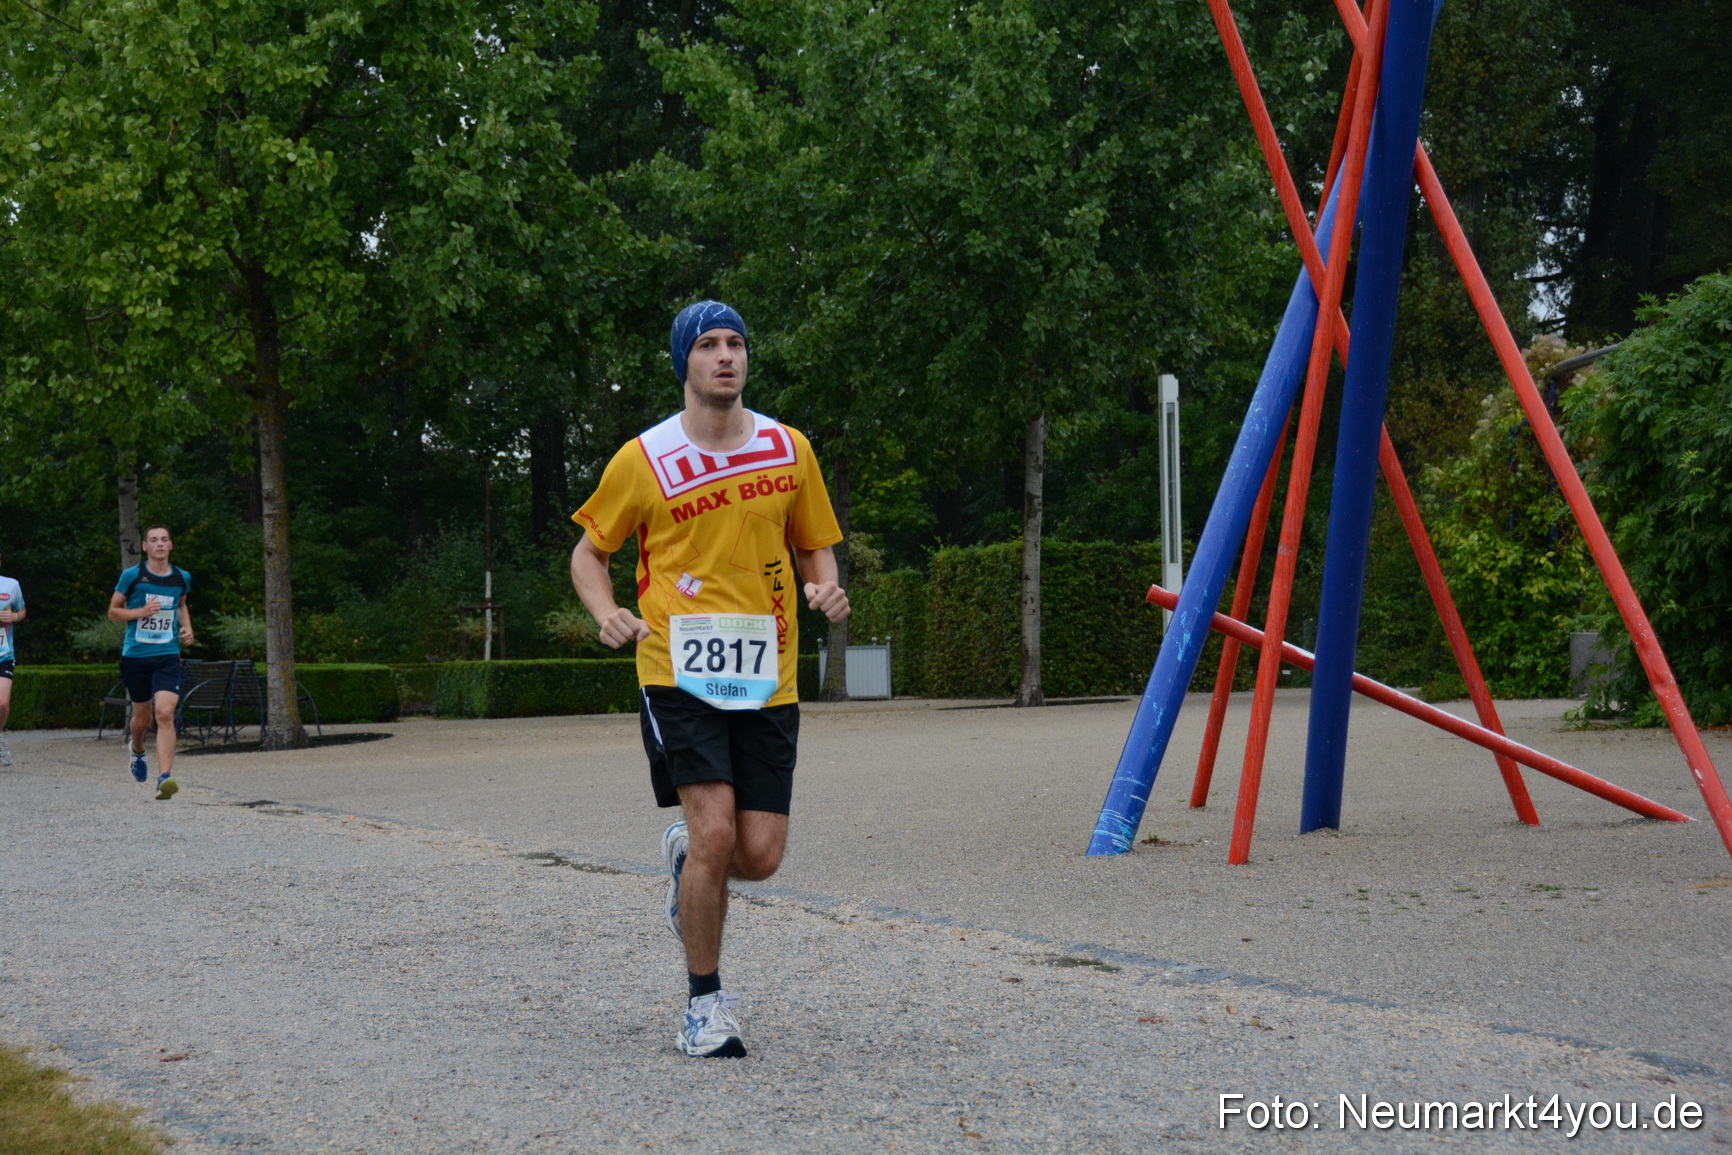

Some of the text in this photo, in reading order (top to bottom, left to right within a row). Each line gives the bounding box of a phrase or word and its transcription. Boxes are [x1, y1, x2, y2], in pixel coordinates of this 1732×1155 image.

[670, 474, 798, 524] MAX BÖGL
[141, 617, 171, 631] 2515
[719, 617, 767, 631] BOCK
[683, 638, 767, 674] 2817
[705, 682, 748, 697] Stefan
